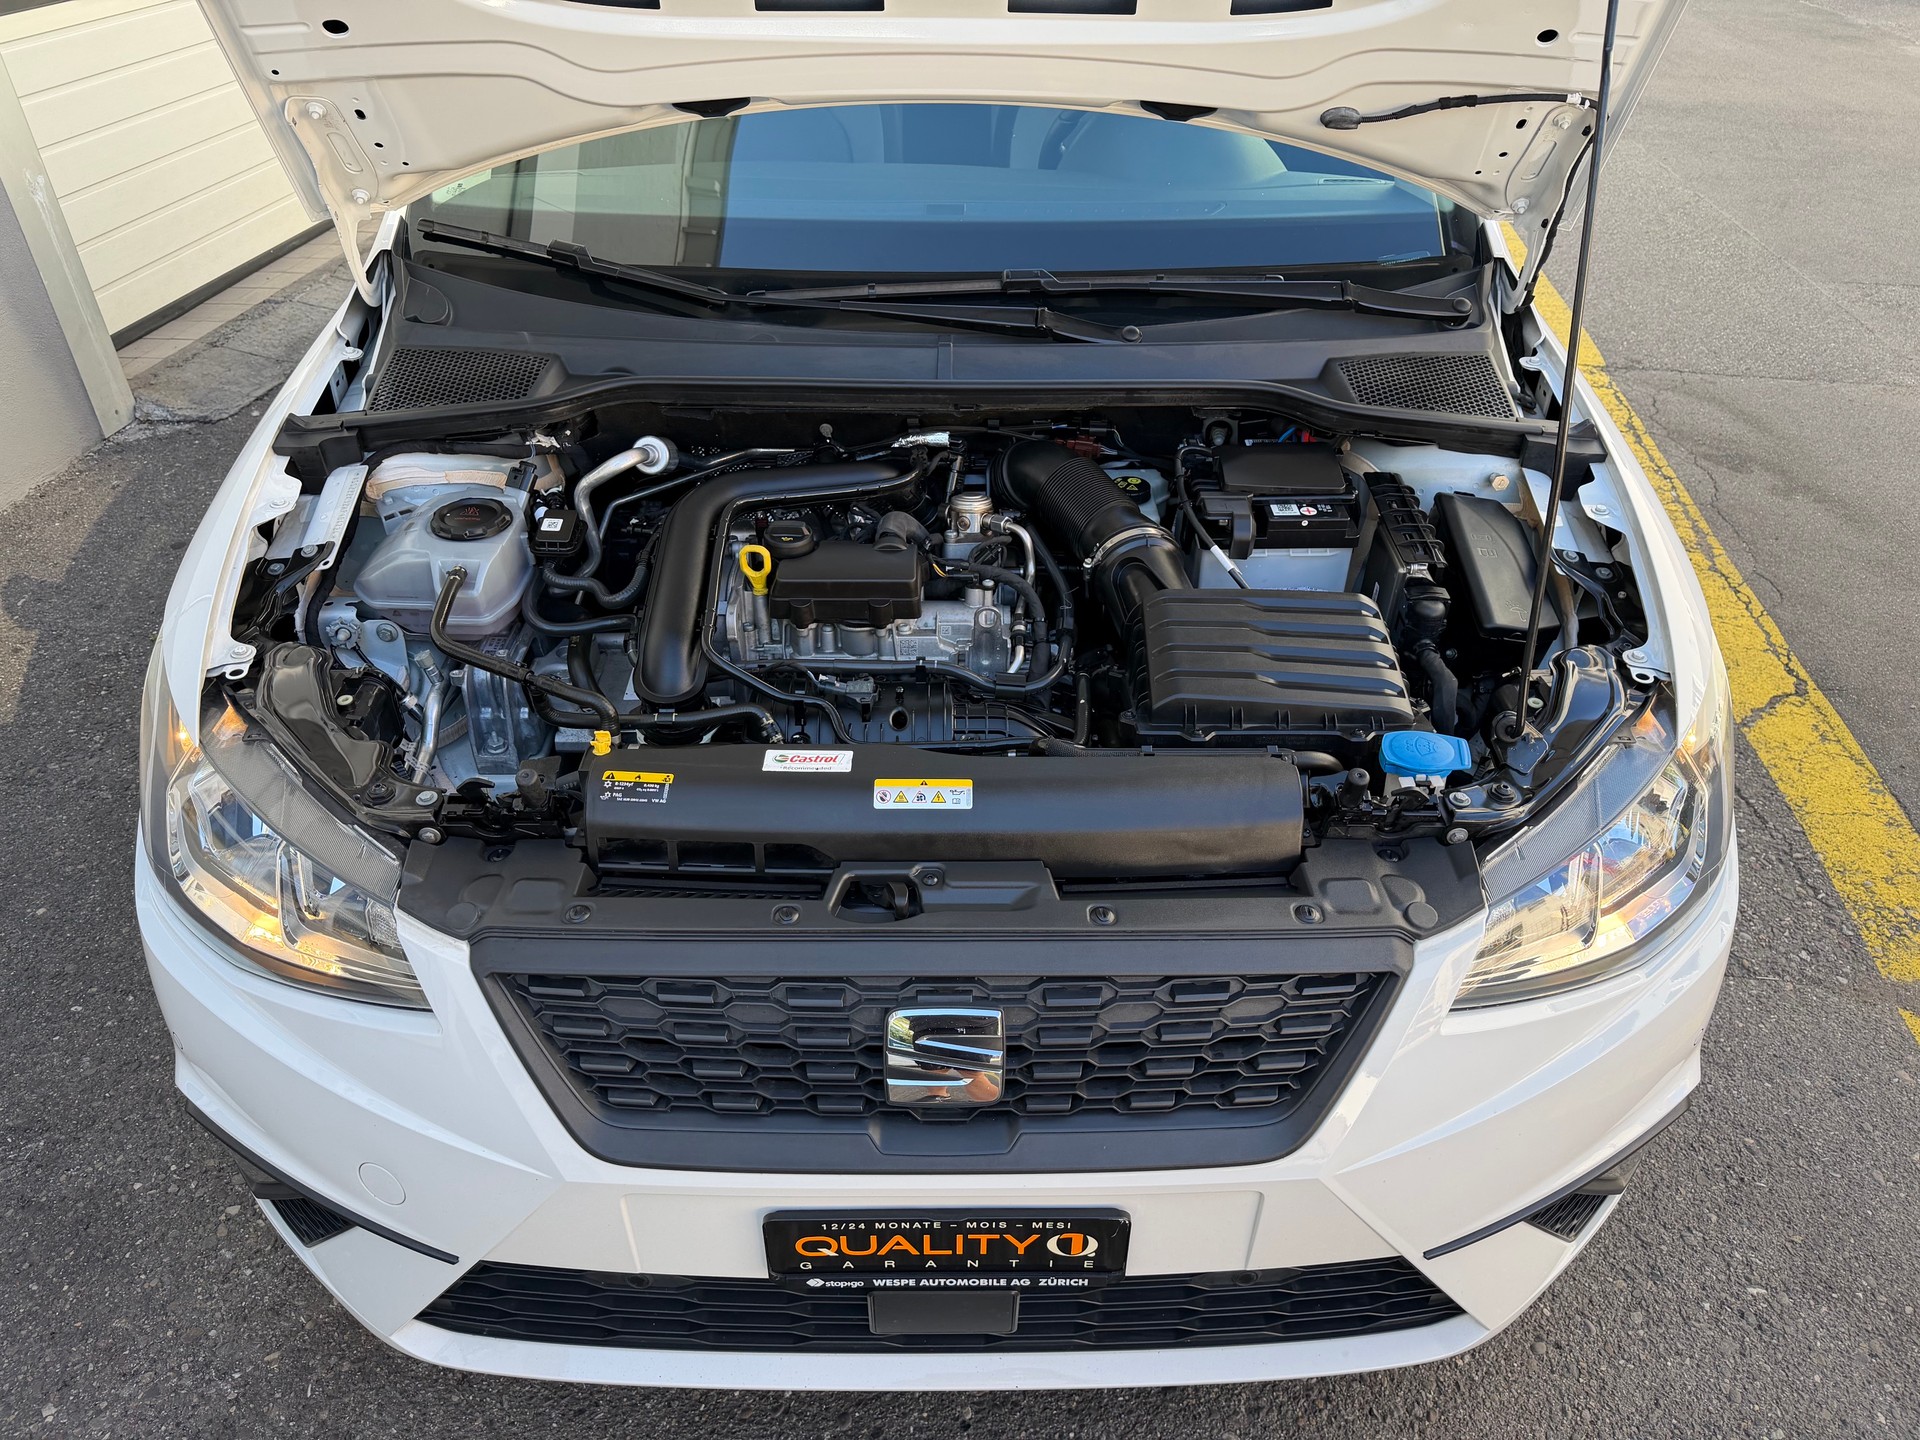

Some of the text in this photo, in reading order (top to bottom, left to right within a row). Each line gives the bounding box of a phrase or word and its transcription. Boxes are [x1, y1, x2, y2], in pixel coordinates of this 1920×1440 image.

[789, 754, 839, 763] Castrol
[821, 1222, 866, 1230] 12/24
[875, 1221, 942, 1230] MONATE
[966, 1221, 1007, 1229] MOIS
[794, 1233, 1041, 1257] QUALITY
[799, 1259, 1095, 1270] GARANTIE
[872, 1278, 916, 1286] WESPE
[919, 1278, 1007, 1286] AUTOMOBILE
[1010, 1278, 1031, 1286] AG
[1038, 1276, 1089, 1286] ZÜRICH
